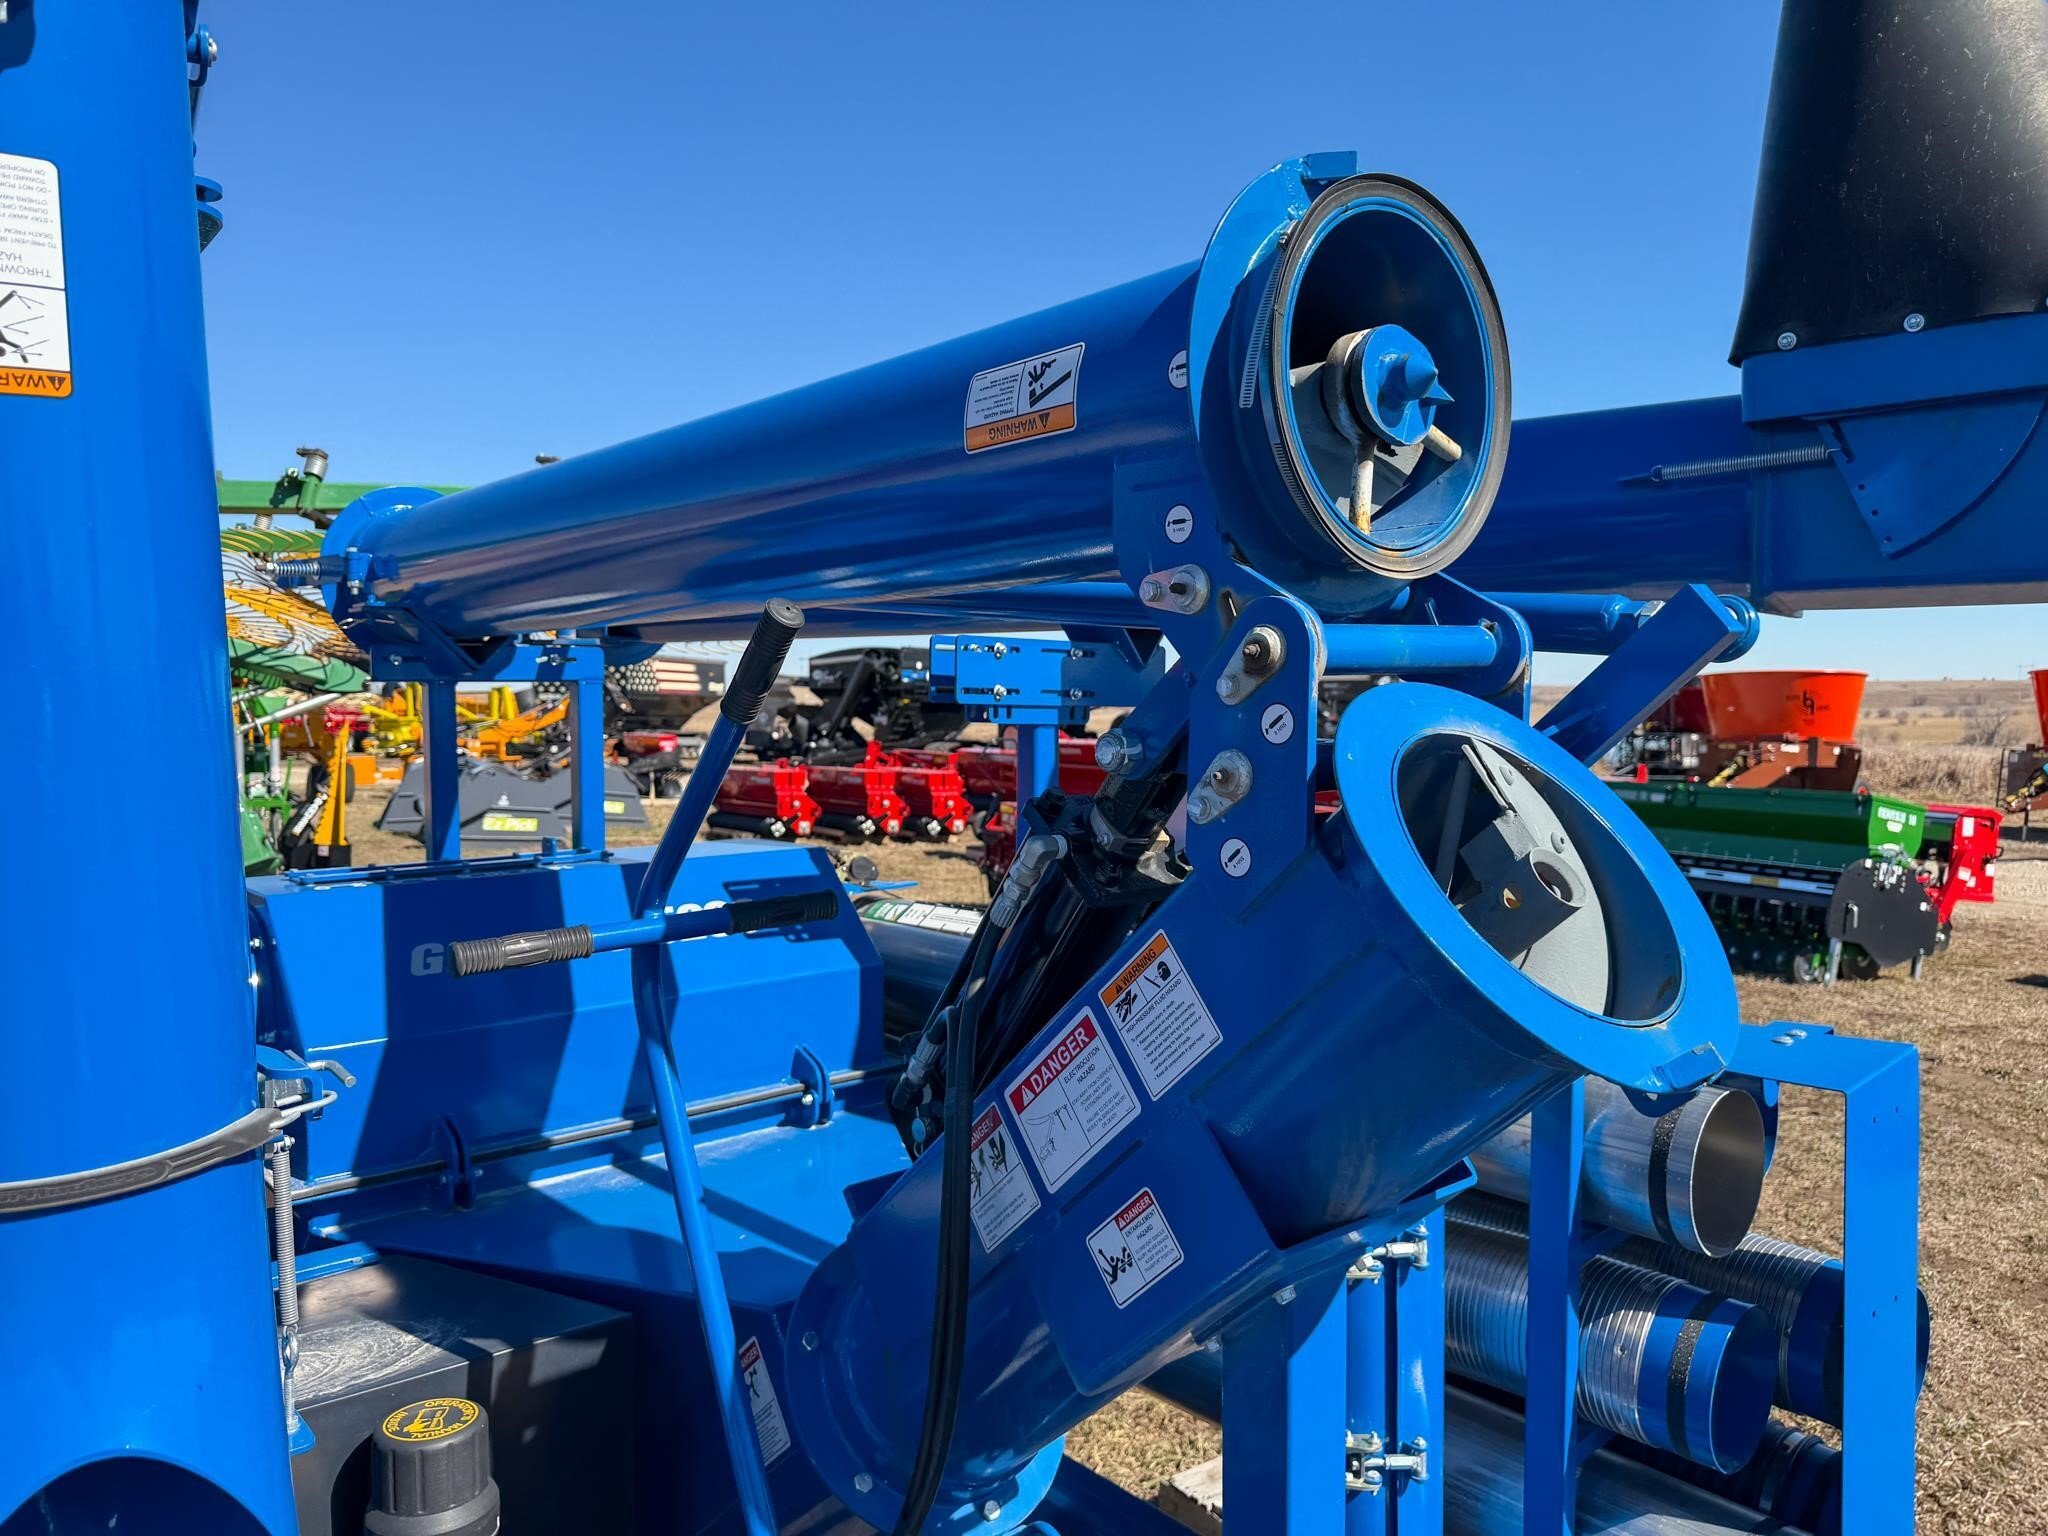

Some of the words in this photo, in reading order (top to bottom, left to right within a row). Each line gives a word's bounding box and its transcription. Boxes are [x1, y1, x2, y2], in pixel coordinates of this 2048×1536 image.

[983, 411, 998, 419] HAZARD
[987, 416, 1037, 441] WARNING
[1120, 947, 1156, 987] WARNING
[1125, 1003, 1155, 1034] HIGH-PRESSURE
[1153, 992, 1166, 1007] FLUID
[1164, 977, 1182, 996] HAZARD
[1030, 1024, 1089, 1093] DANGER
[1063, 1043, 1100, 1084] ELECTROCUTION
[1076, 1062, 1095, 1084] HAZARD
[971, 1113, 996, 1146] ANGER
[1123, 1194, 1151, 1223] DANGER
[1124, 1208, 1155, 1237] ENTANGLEMENT
[1135, 1222, 1153, 1241] HAZARD
[387, 1411, 409, 1432] INSIDE
[410, 1422, 464, 1439] MANUAL
